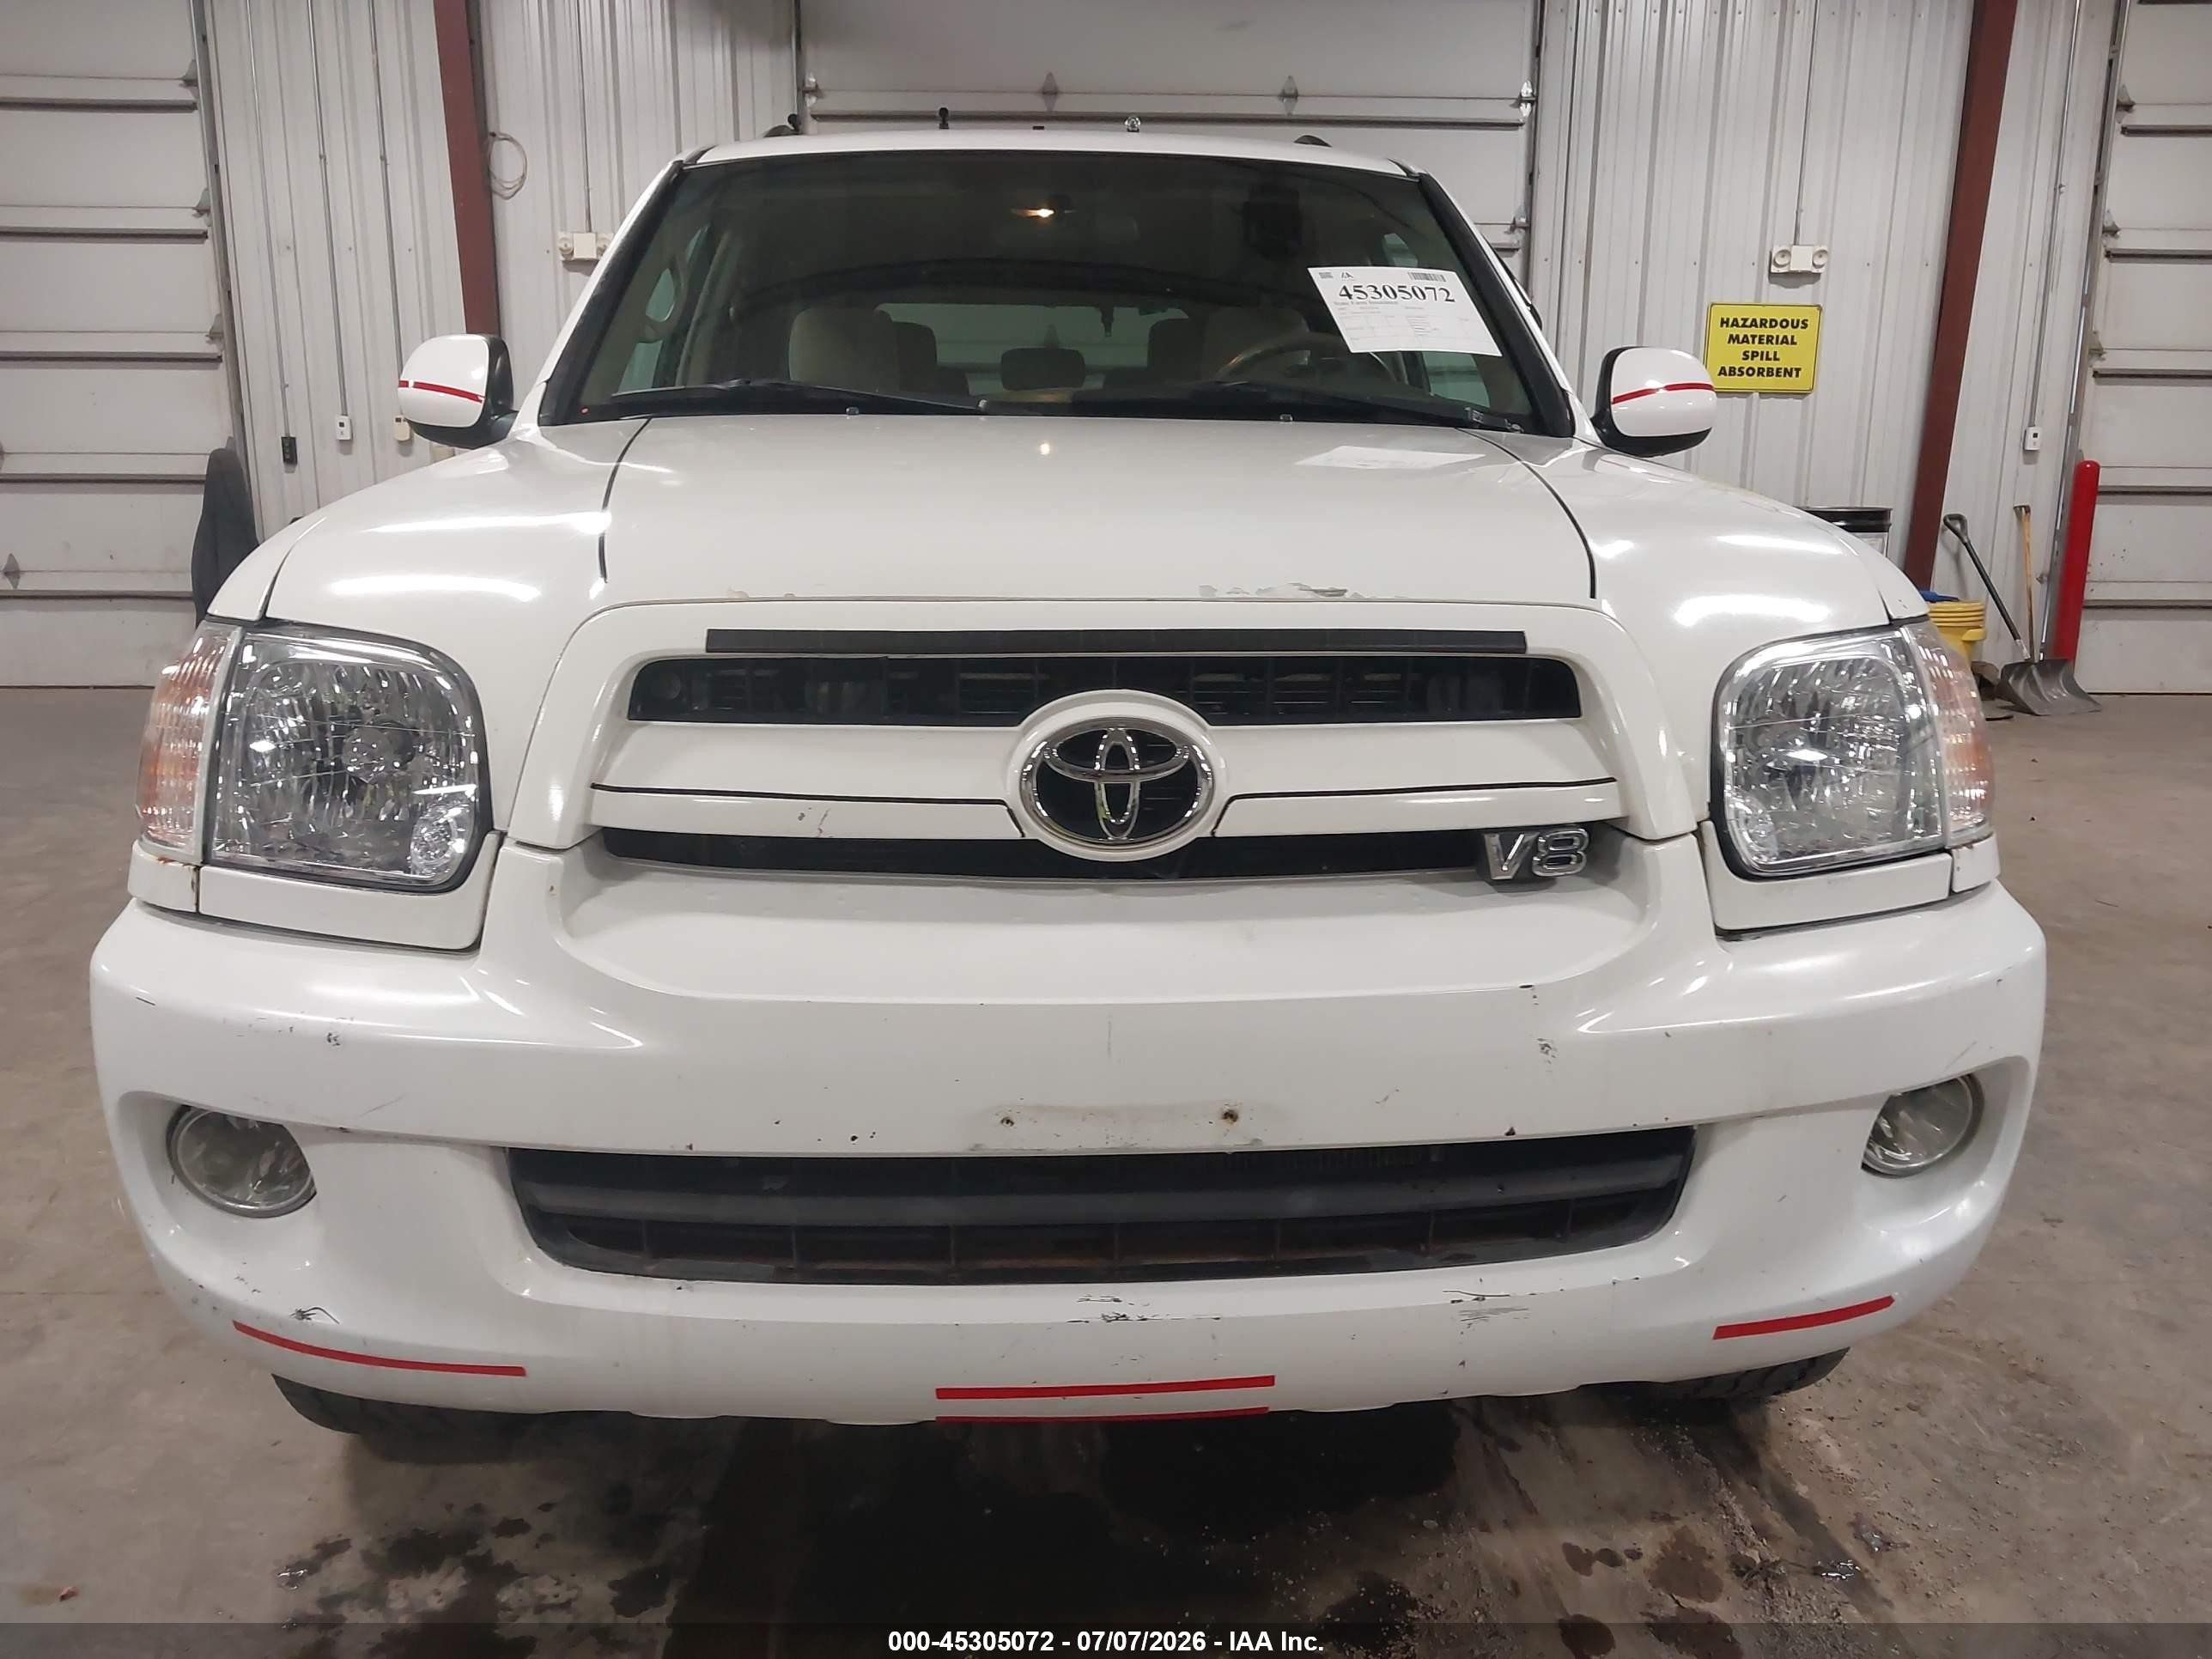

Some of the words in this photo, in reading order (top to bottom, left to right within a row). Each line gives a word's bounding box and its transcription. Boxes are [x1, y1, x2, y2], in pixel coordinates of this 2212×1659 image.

[1339, 284, 1455, 302] 45305072
[1719, 318, 1809, 330] HAZARDOUS
[1727, 333, 1797, 345] MATERIAL
[1741, 350, 1781, 362] SPILL
[1717, 366, 1802, 378] ABSORBENT
[1483, 827, 1590, 880] V8
